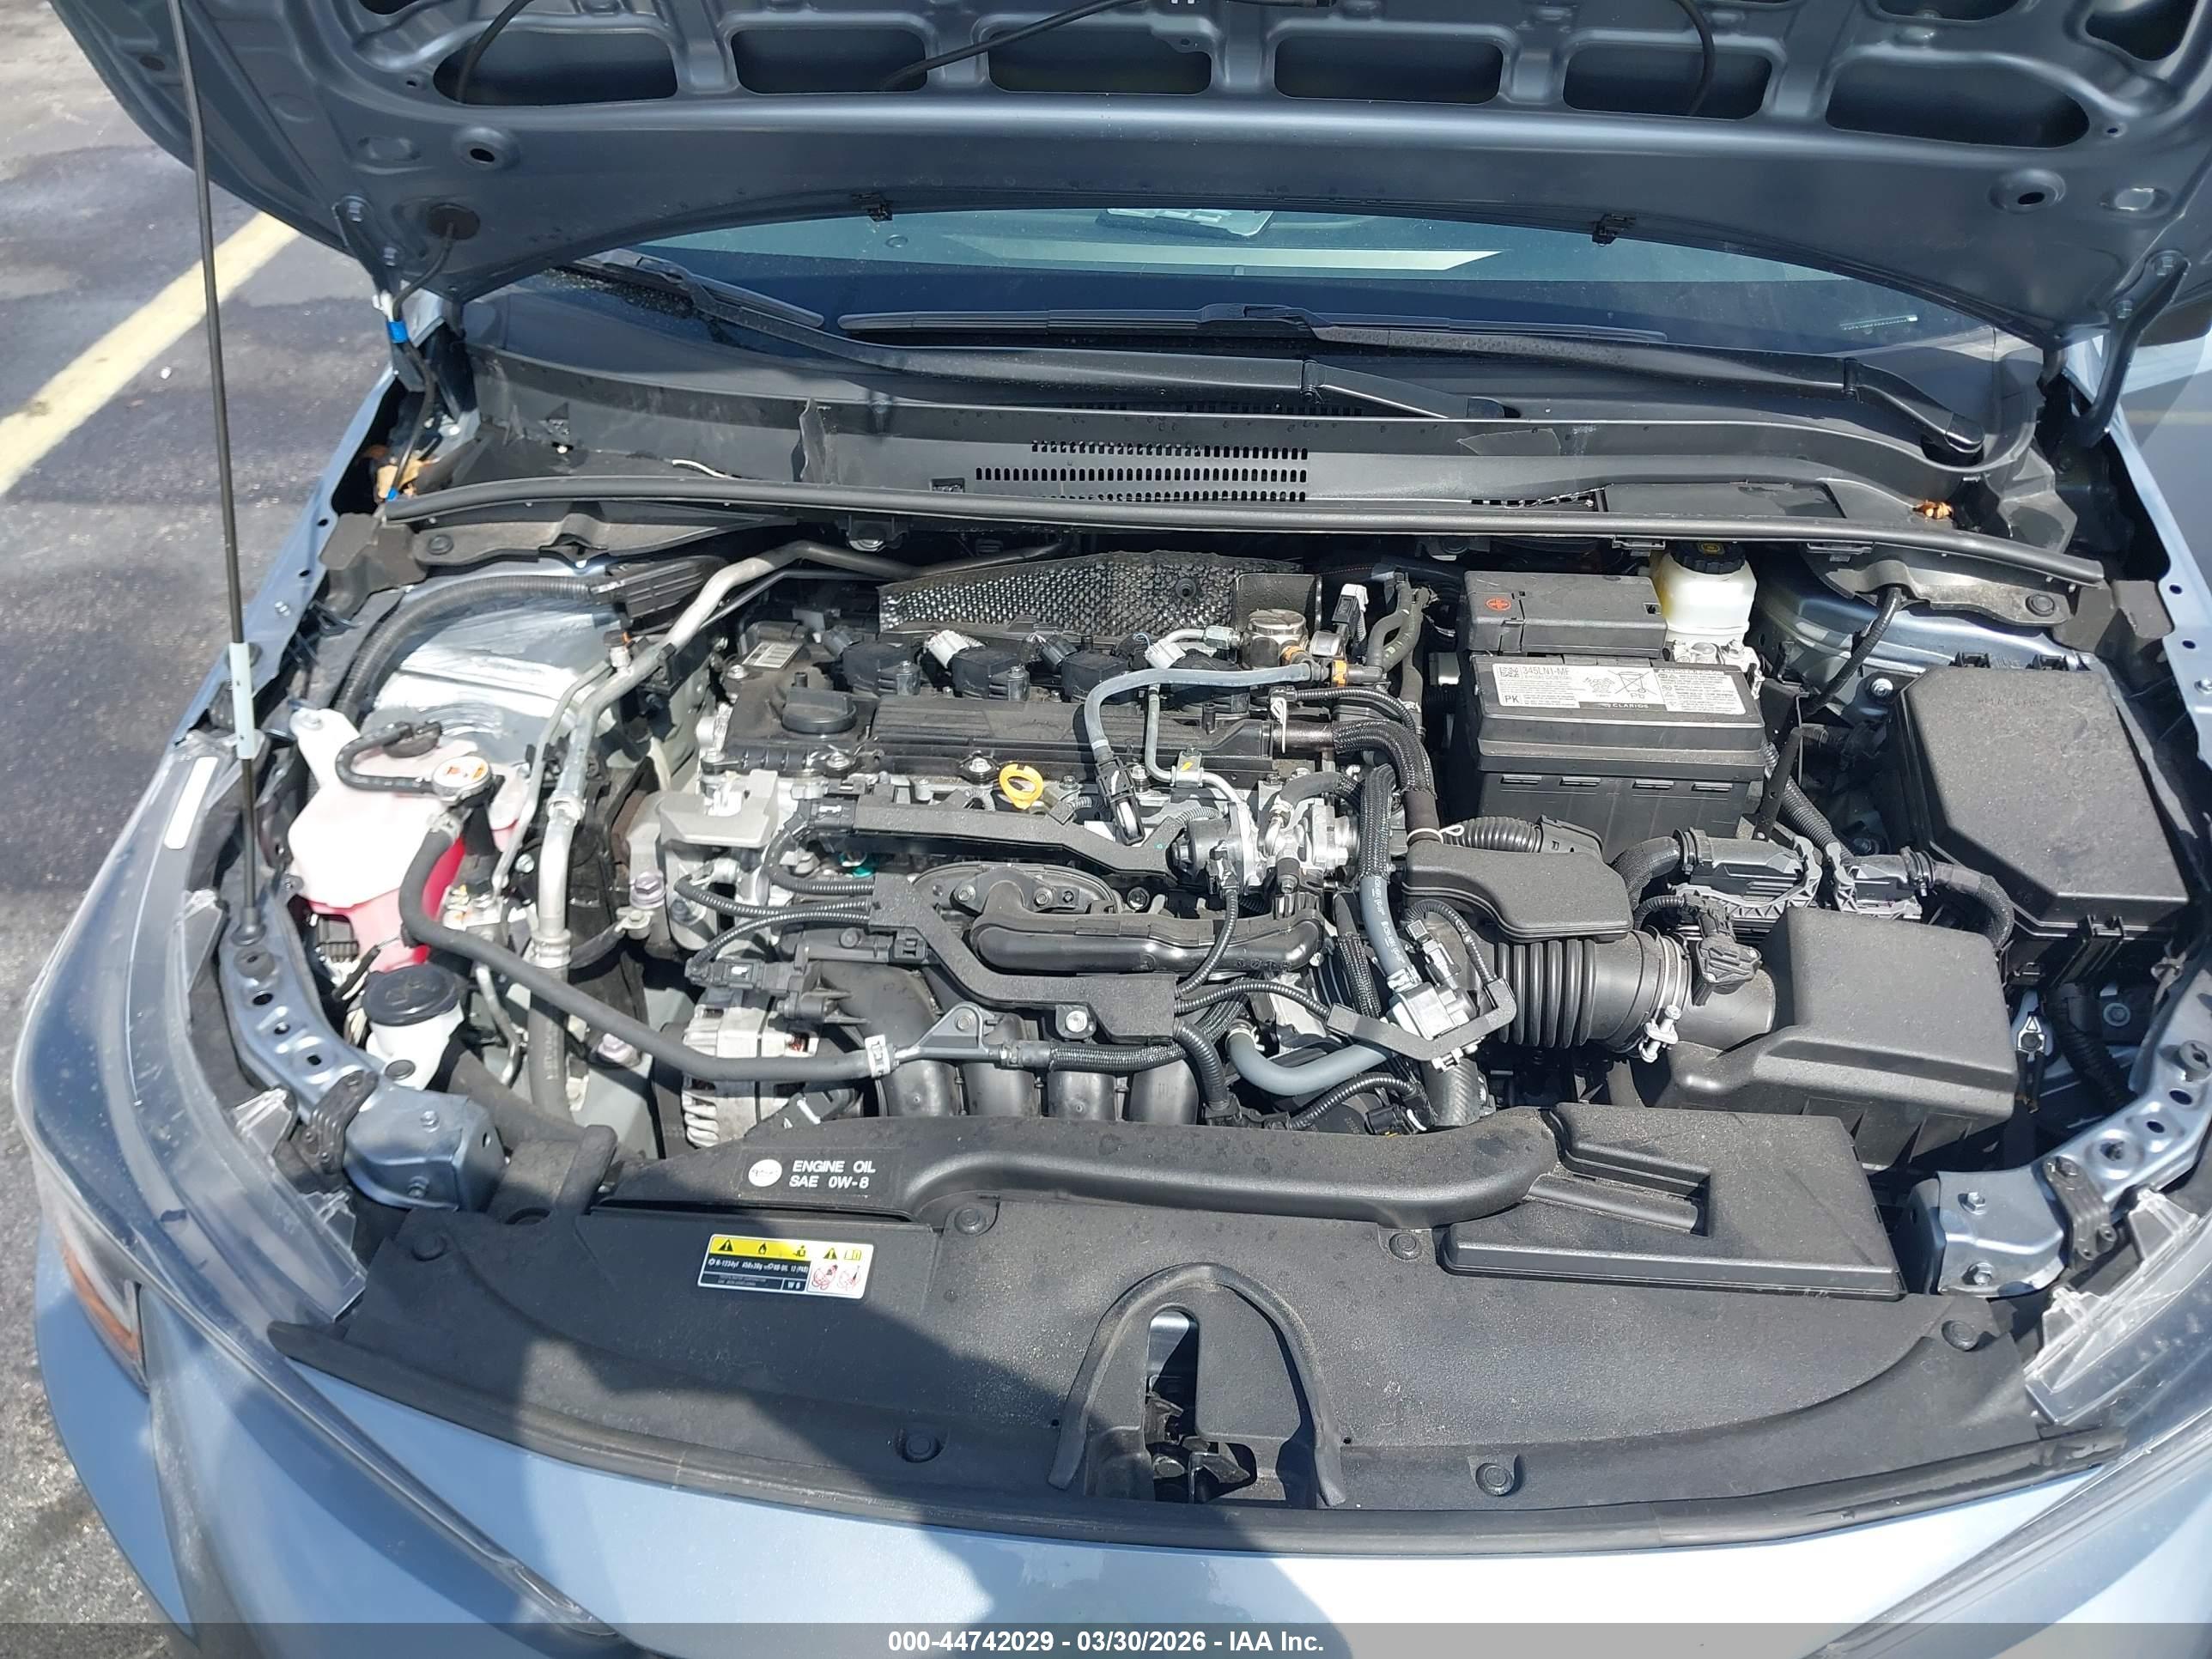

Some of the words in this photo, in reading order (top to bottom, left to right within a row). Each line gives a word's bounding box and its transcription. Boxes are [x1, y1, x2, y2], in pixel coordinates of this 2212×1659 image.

[1504, 695, 1519, 703] PK
[793, 1160, 846, 1173] ENGINE
[853, 1160, 876, 1173] OIL
[789, 1175, 819, 1188] SAE
[828, 1176, 869, 1188] 0W-8
